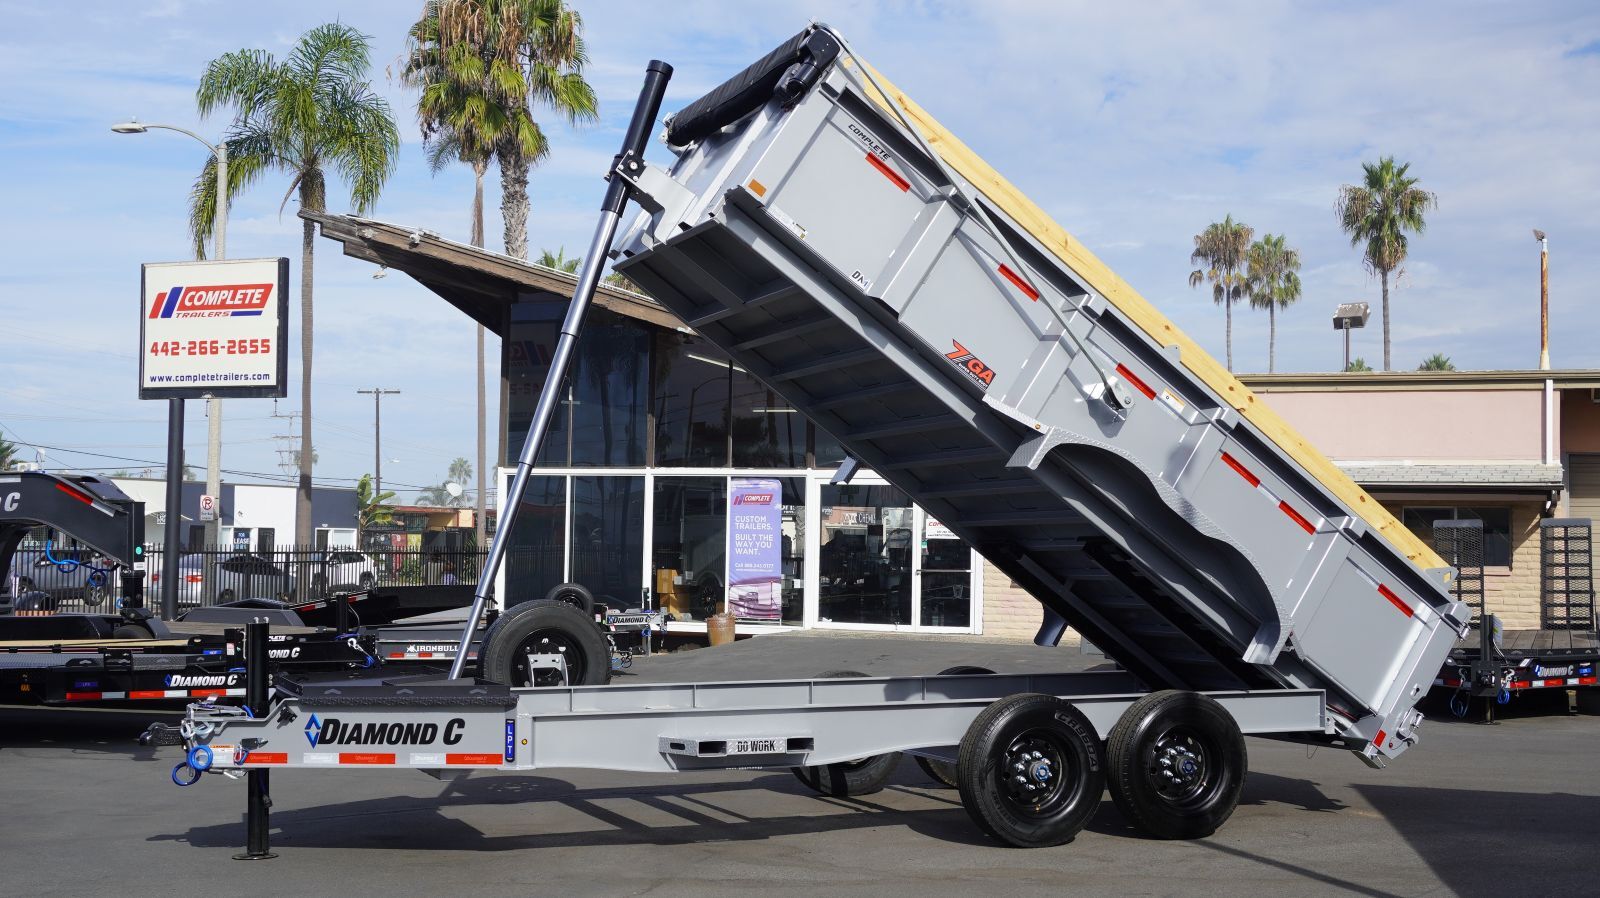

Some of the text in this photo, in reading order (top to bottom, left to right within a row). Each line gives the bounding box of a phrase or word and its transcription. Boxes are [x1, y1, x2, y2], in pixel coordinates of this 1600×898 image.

[848, 124, 891, 160] COMPLETE
[184, 288, 265, 307] COMPLETE
[150, 339, 271, 356] 442-266-2655
[150, 372, 270, 383] www.completetrailers.com
[735, 515, 767, 523] CUSTOM
[735, 533, 757, 541] BUILT
[170, 674, 238, 687] DIAMOND C
[318, 718, 466, 745] DIAMOND C
[737, 740, 775, 752] DO WORK
